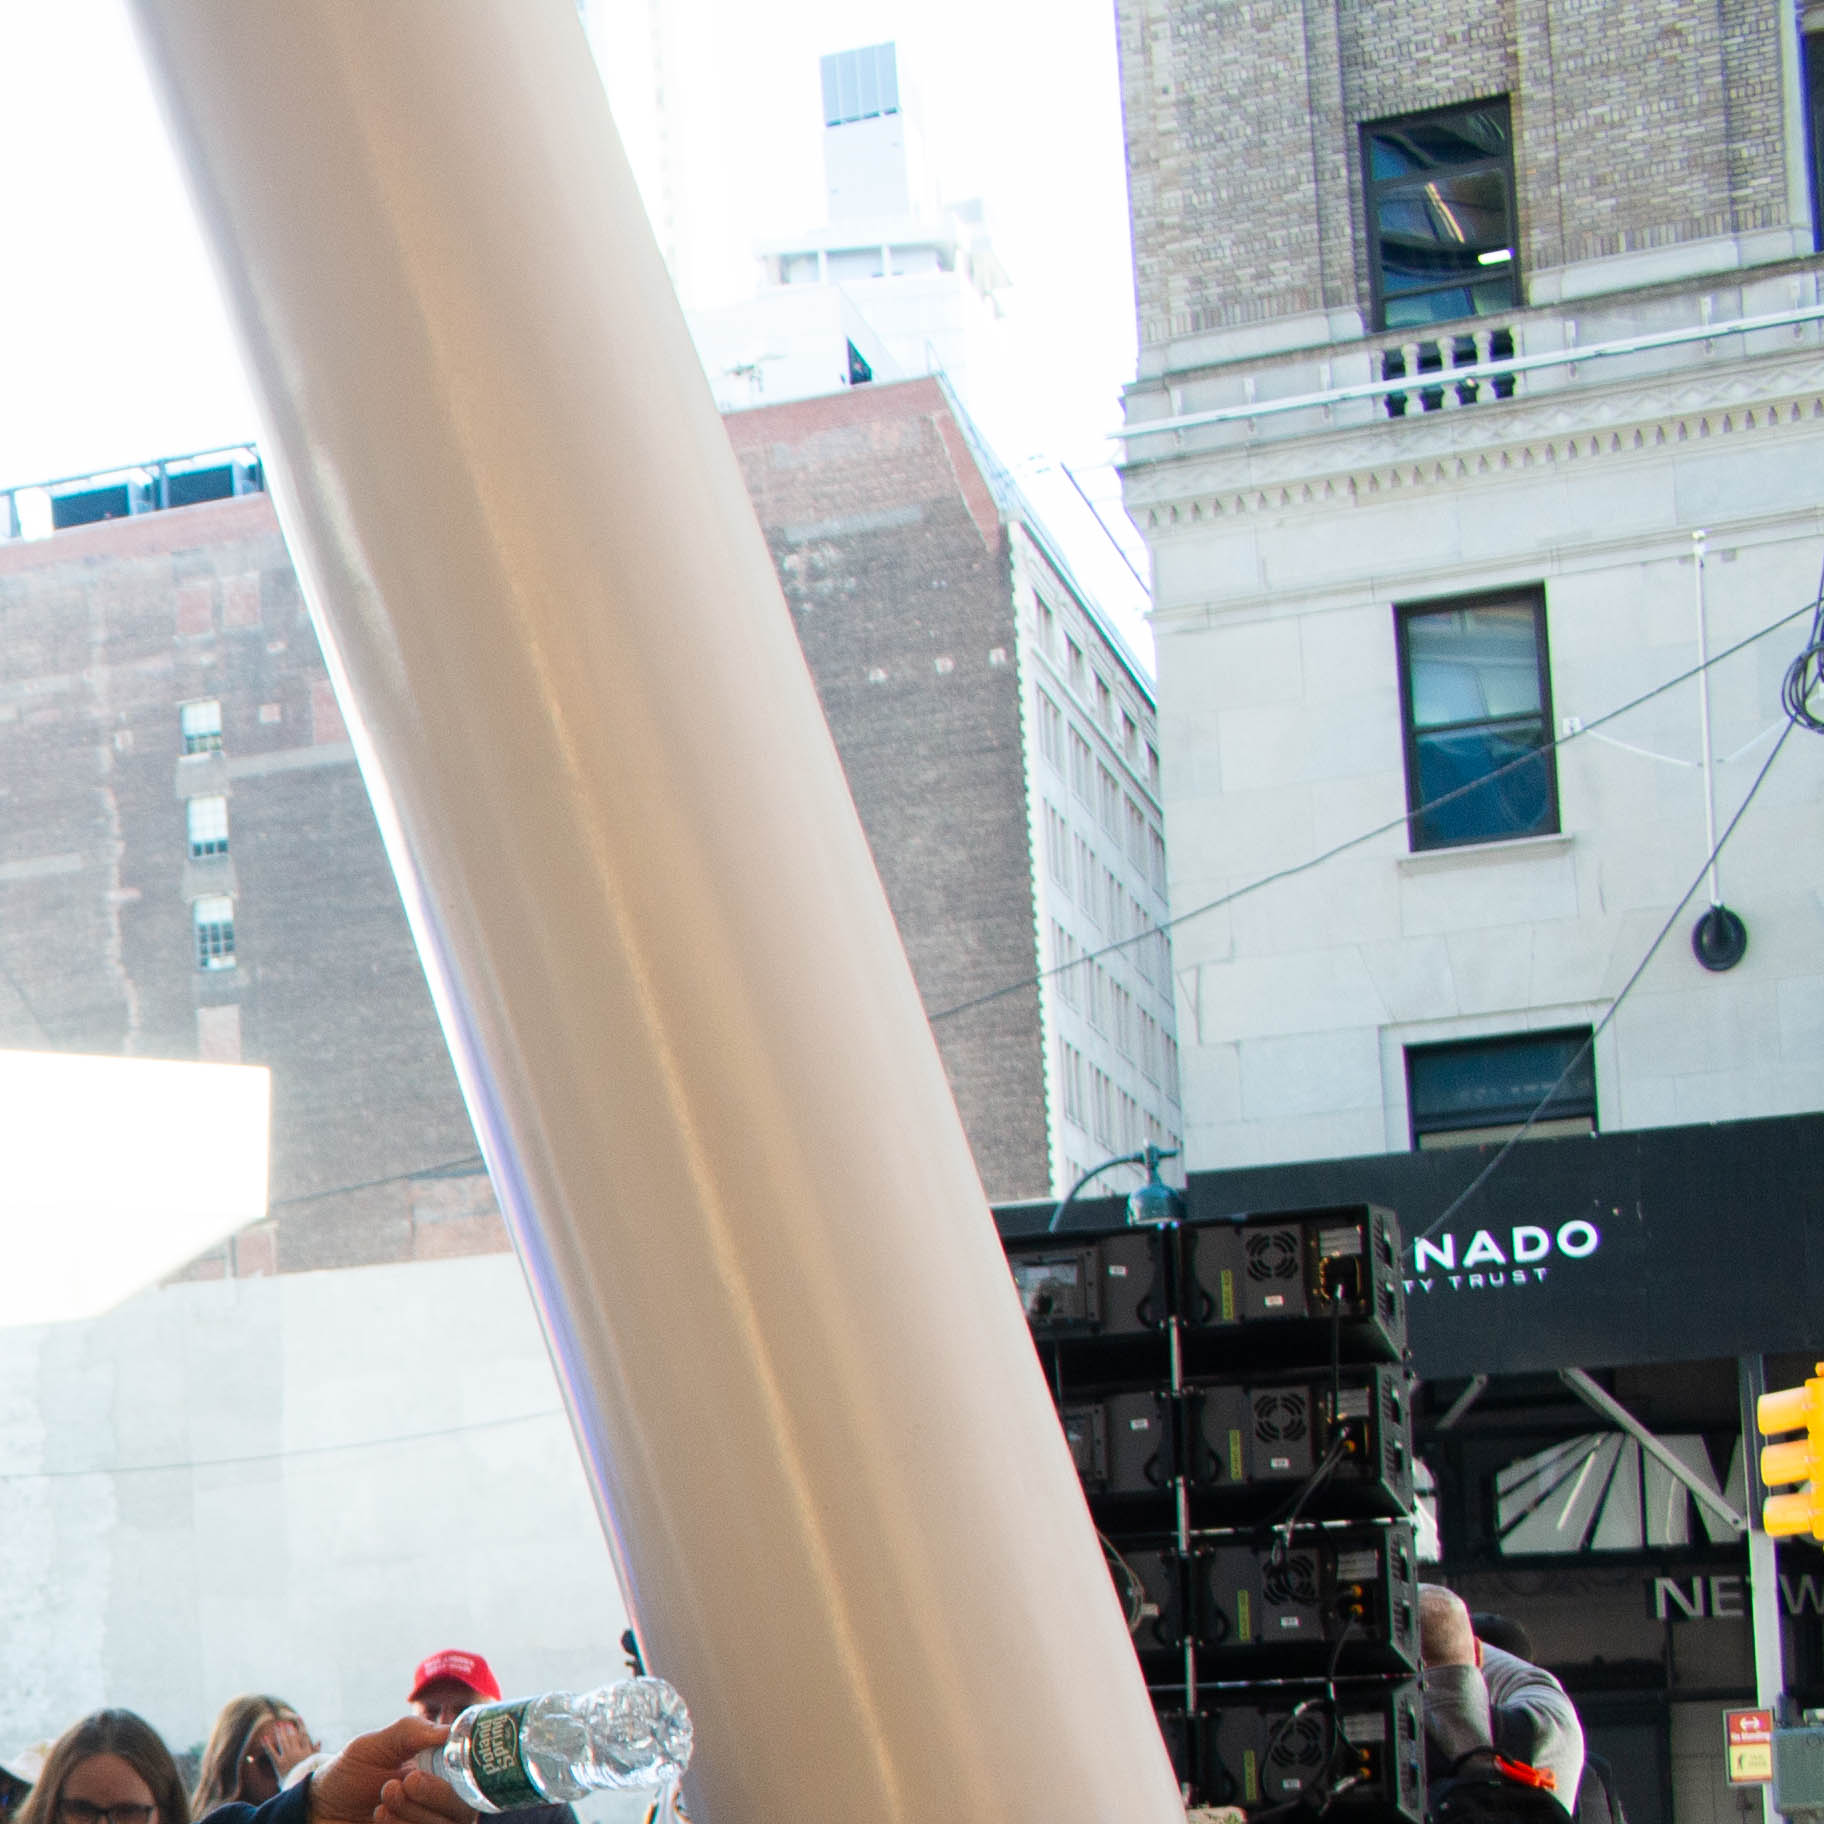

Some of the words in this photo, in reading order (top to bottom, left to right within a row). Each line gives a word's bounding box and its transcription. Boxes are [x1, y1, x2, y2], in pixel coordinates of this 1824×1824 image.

[1414, 1220, 1598, 1273] NADO
[1402, 1277, 1434, 1296] TY
[1448, 1266, 1551, 1292] TRUST
[477, 1719, 501, 1776] Poland
[491, 1714, 515, 1769] Spring
